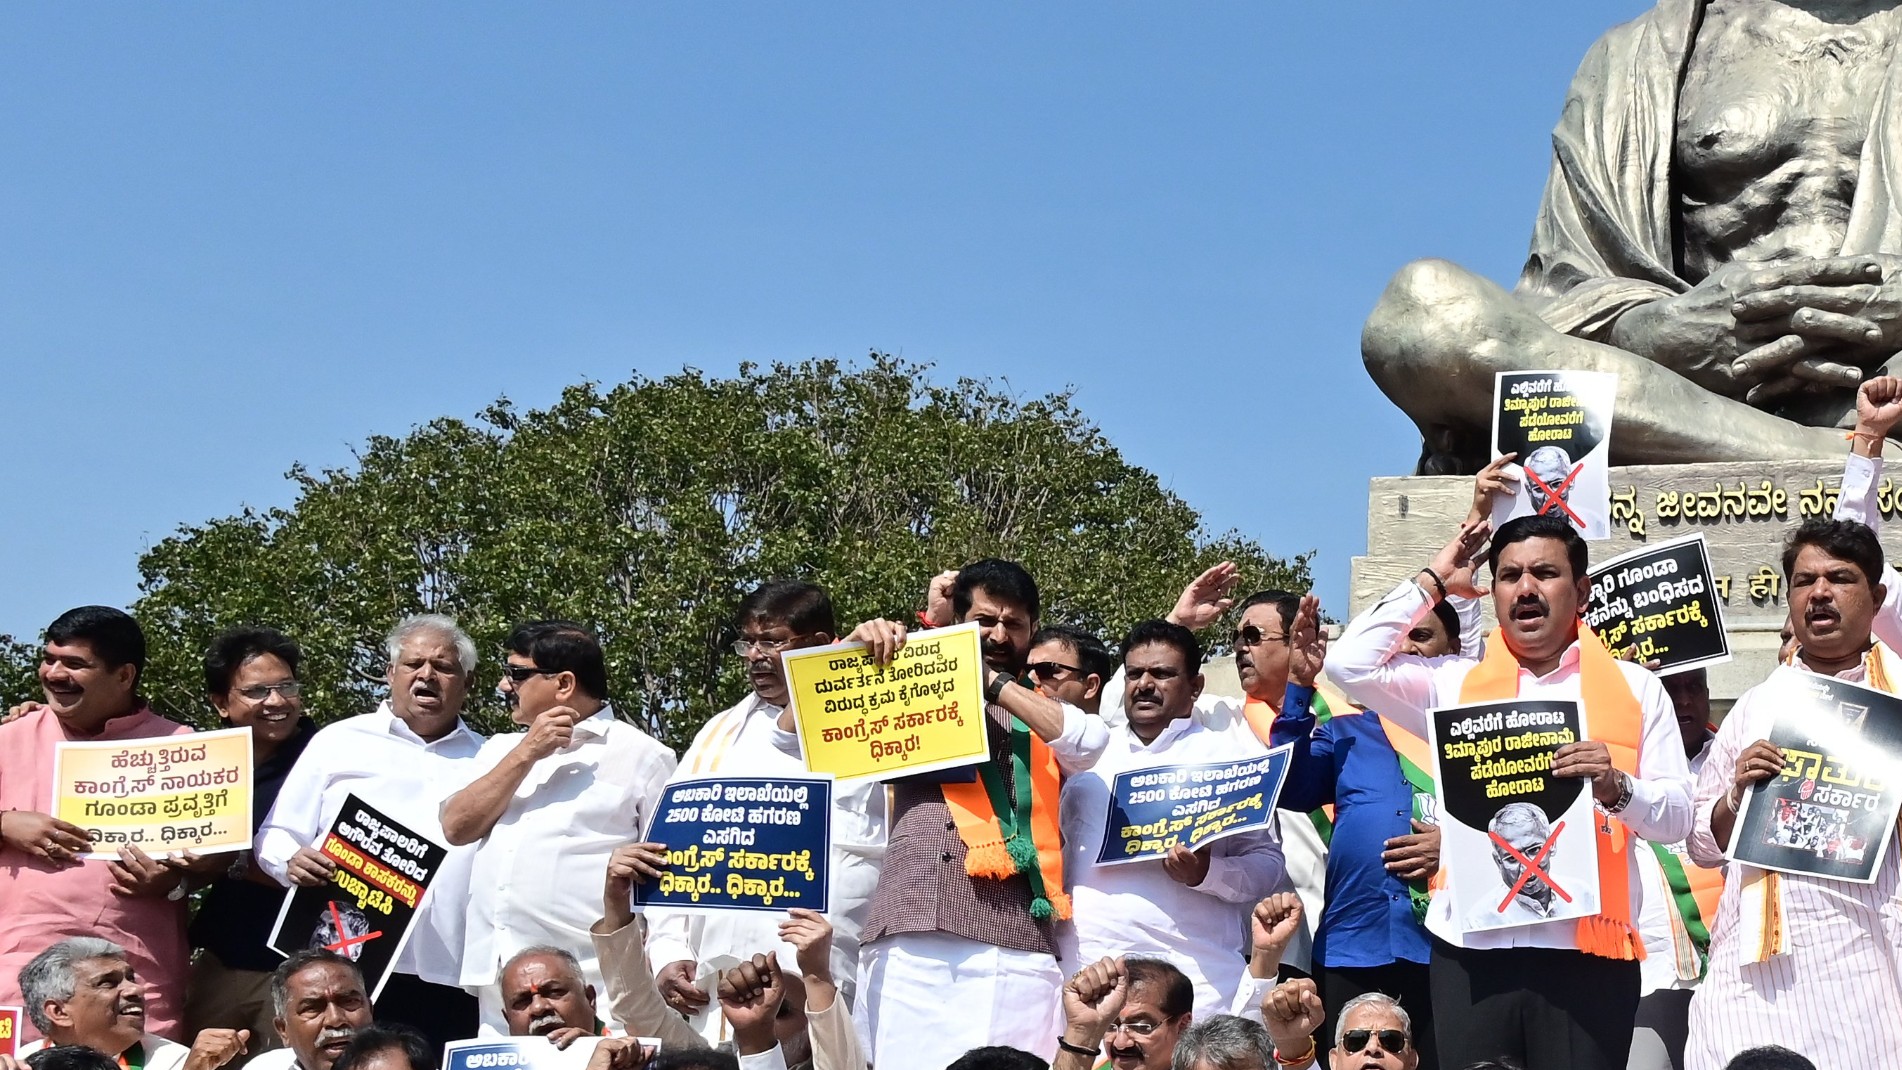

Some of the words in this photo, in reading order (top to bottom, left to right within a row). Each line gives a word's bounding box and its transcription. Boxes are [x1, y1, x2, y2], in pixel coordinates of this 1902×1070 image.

[1655, 480, 1788, 518] ಜೀವನವೇ
[1617, 558, 1678, 587] ಗೂಂಡಾ
[1633, 574, 1704, 609] ಬಂಧಿಸದ
[821, 716, 889, 743] ಕಾಂಗ್ರೆಸ್
[1505, 710, 1565, 728] ಹೋರಾಟ
[74, 775, 155, 798] ಕಾಂಗ್ರೆಸ್
[161, 766, 239, 791] ನಾಯಕರ
[1486, 776, 1545, 799] ಹೋರಾಟ
[1128, 788, 1165, 805] 2500
[85, 800, 156, 817] ಗೂಂಡಾ
[665, 807, 699, 823] 2500
[701, 804, 744, 823] ಕೋಟಿ
[703, 827, 755, 846] ಎಸಗಿದ
